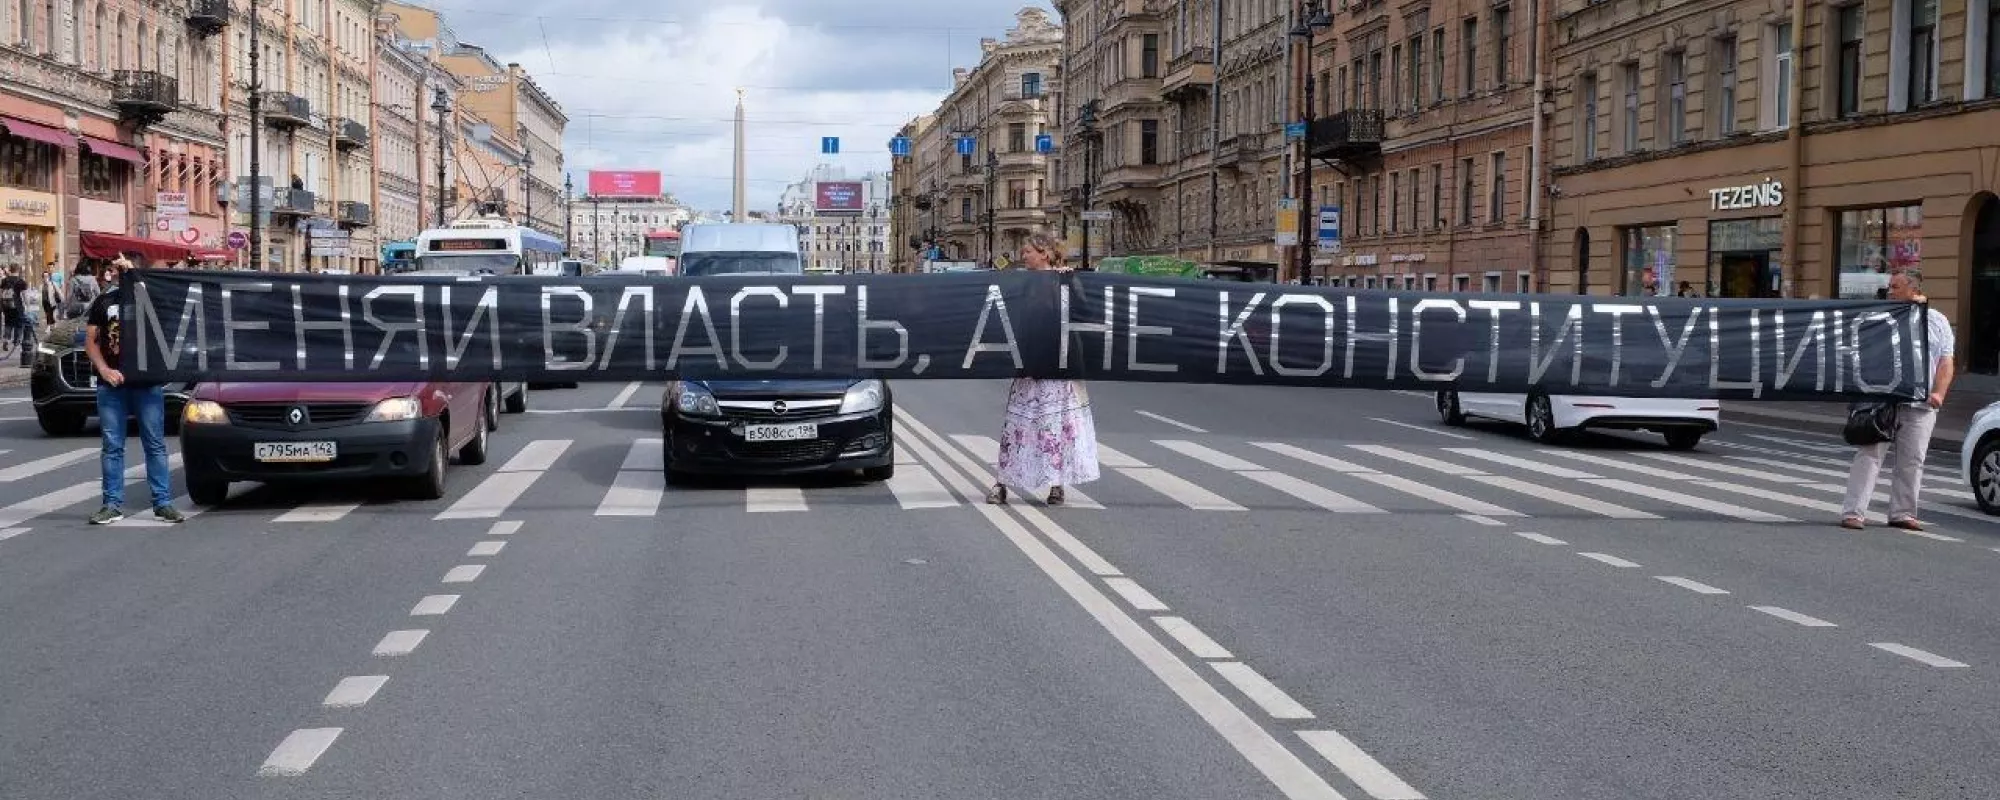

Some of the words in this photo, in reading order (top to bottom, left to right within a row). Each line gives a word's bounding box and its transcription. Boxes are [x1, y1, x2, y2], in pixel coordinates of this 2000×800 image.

[134, 277, 502, 371] МЕНЯЙ
[541, 285, 931, 375] ВЛАСТЬ,
[962, 284, 1024, 369] А
[1058, 284, 1179, 372] НЕ
[1216, 291, 1926, 400] КОНСТИТУЦИЮ!
